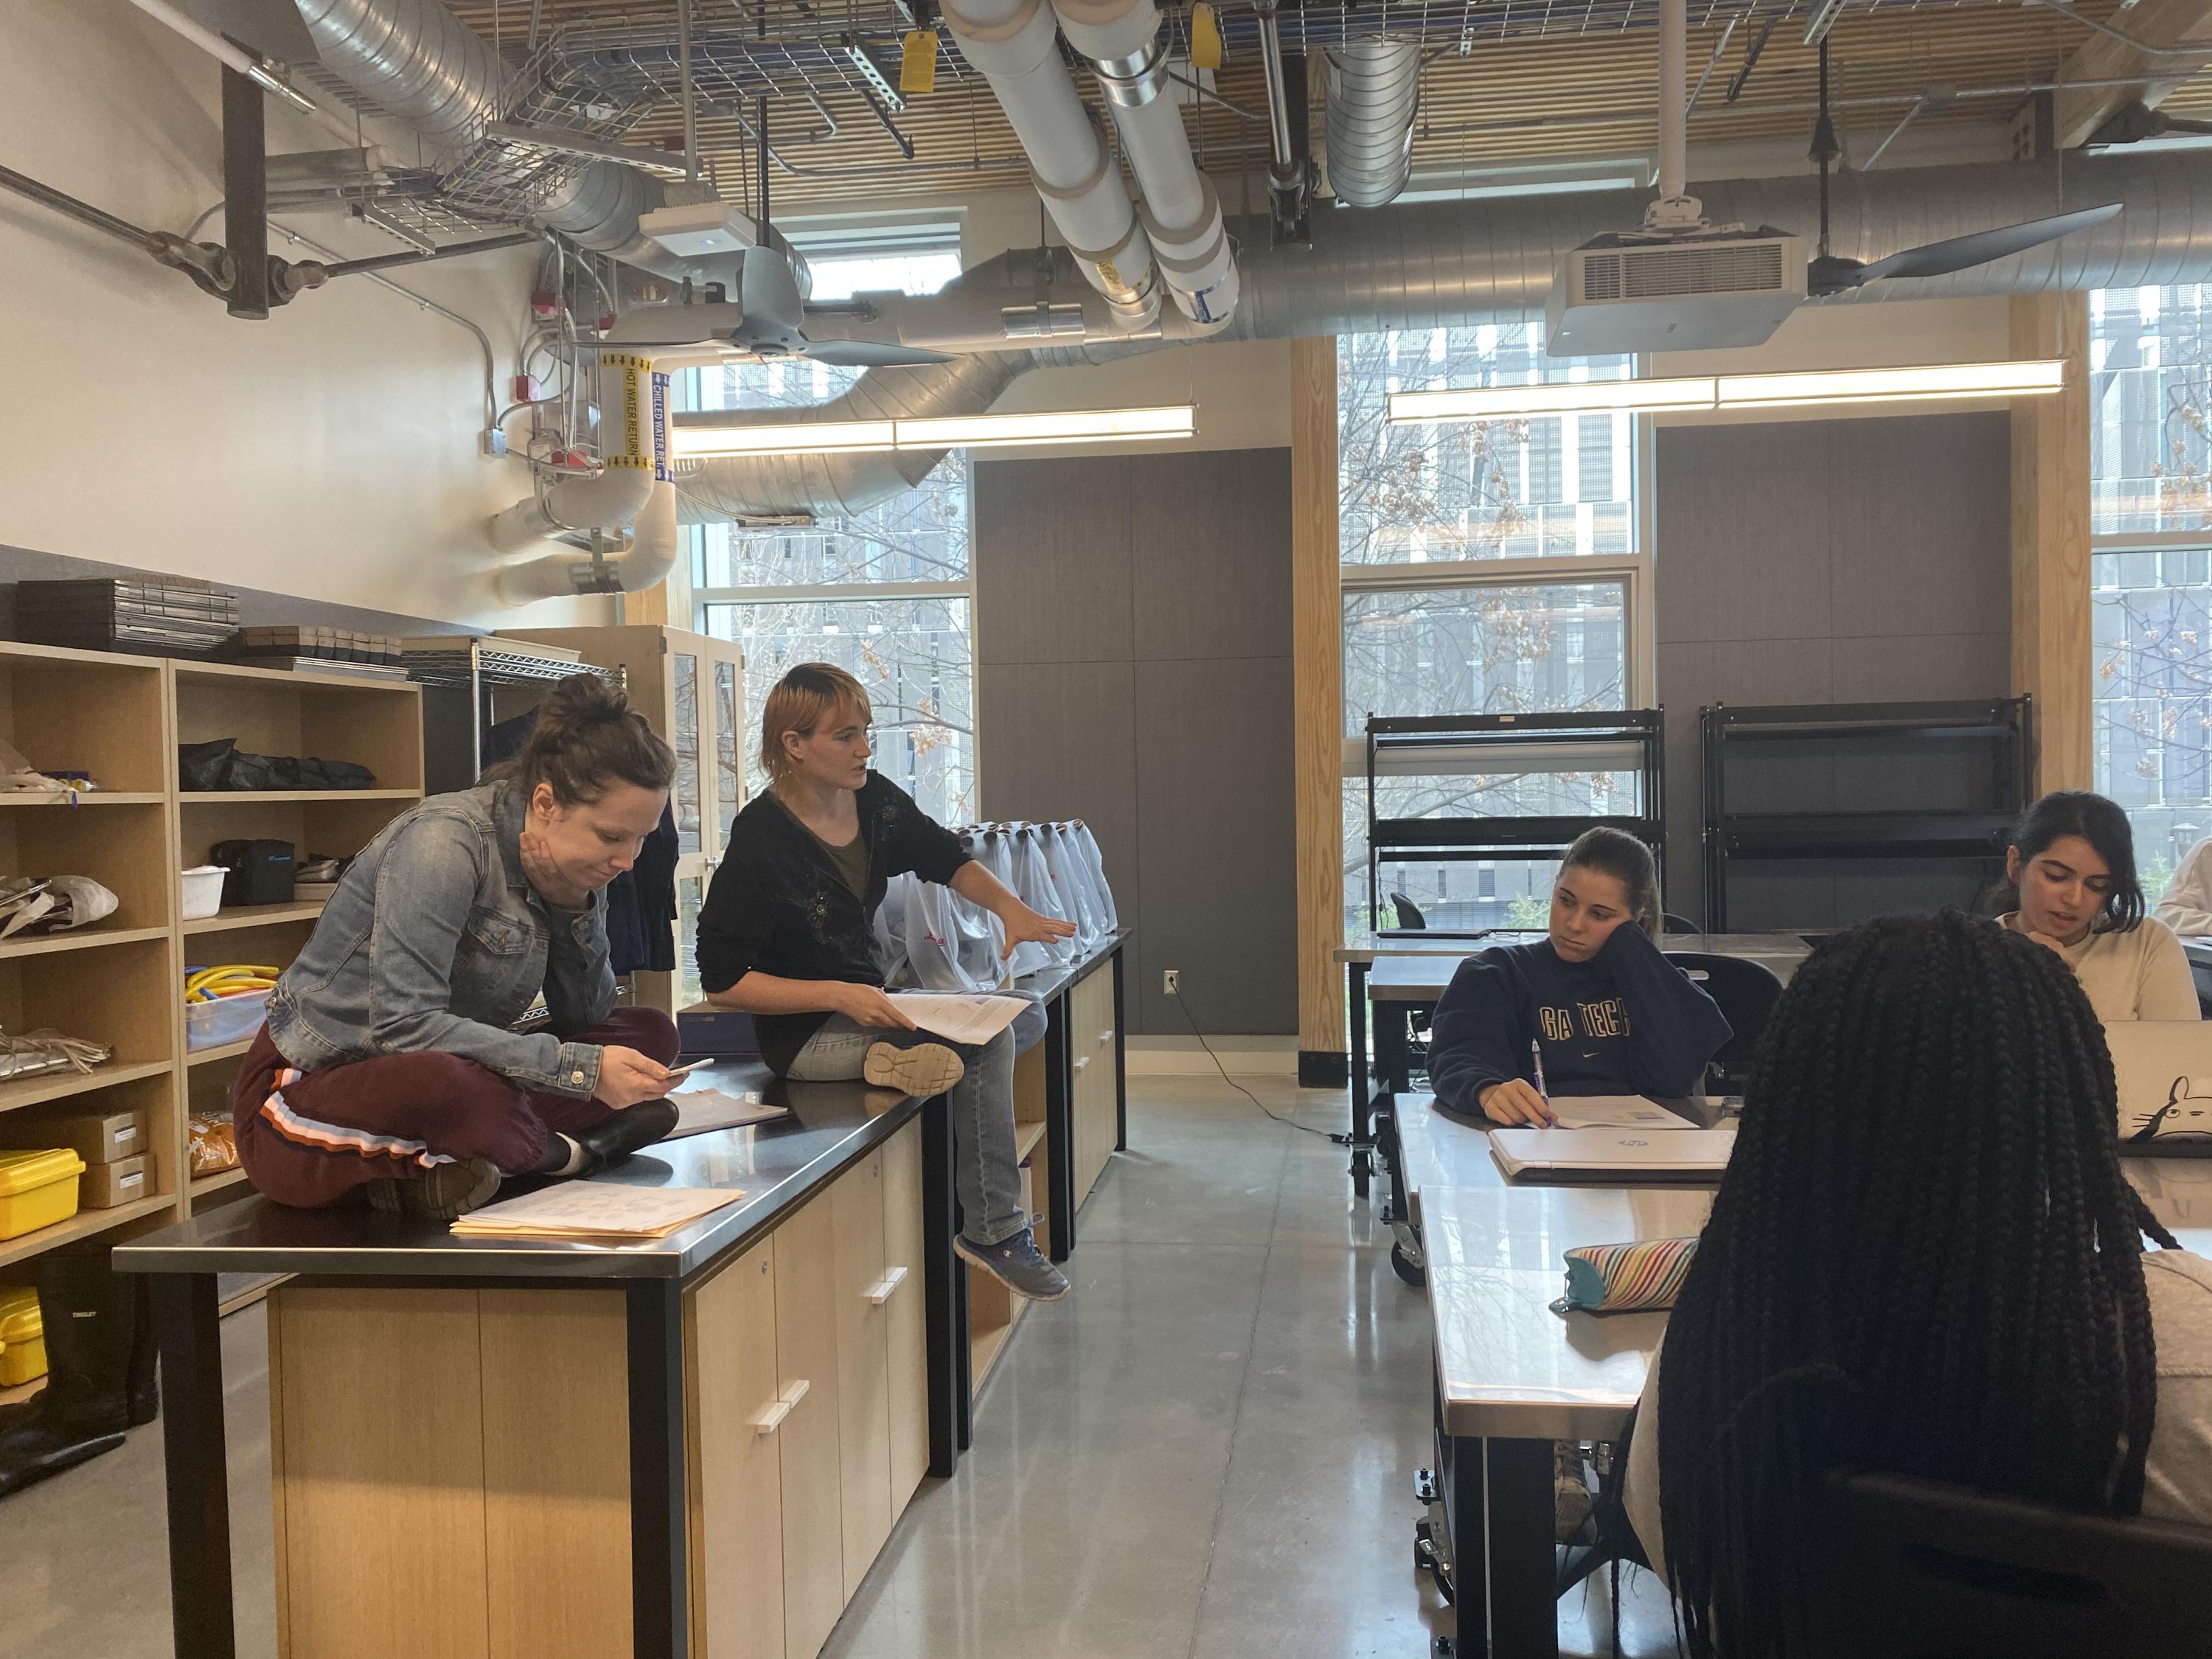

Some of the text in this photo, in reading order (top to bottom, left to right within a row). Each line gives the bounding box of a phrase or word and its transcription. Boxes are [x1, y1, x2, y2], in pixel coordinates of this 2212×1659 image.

[626, 368, 639, 456] HOT WATER RETURN
[653, 385, 665, 469] CHILLED WATER RET.
[1540, 1006, 1573, 1040] GA
